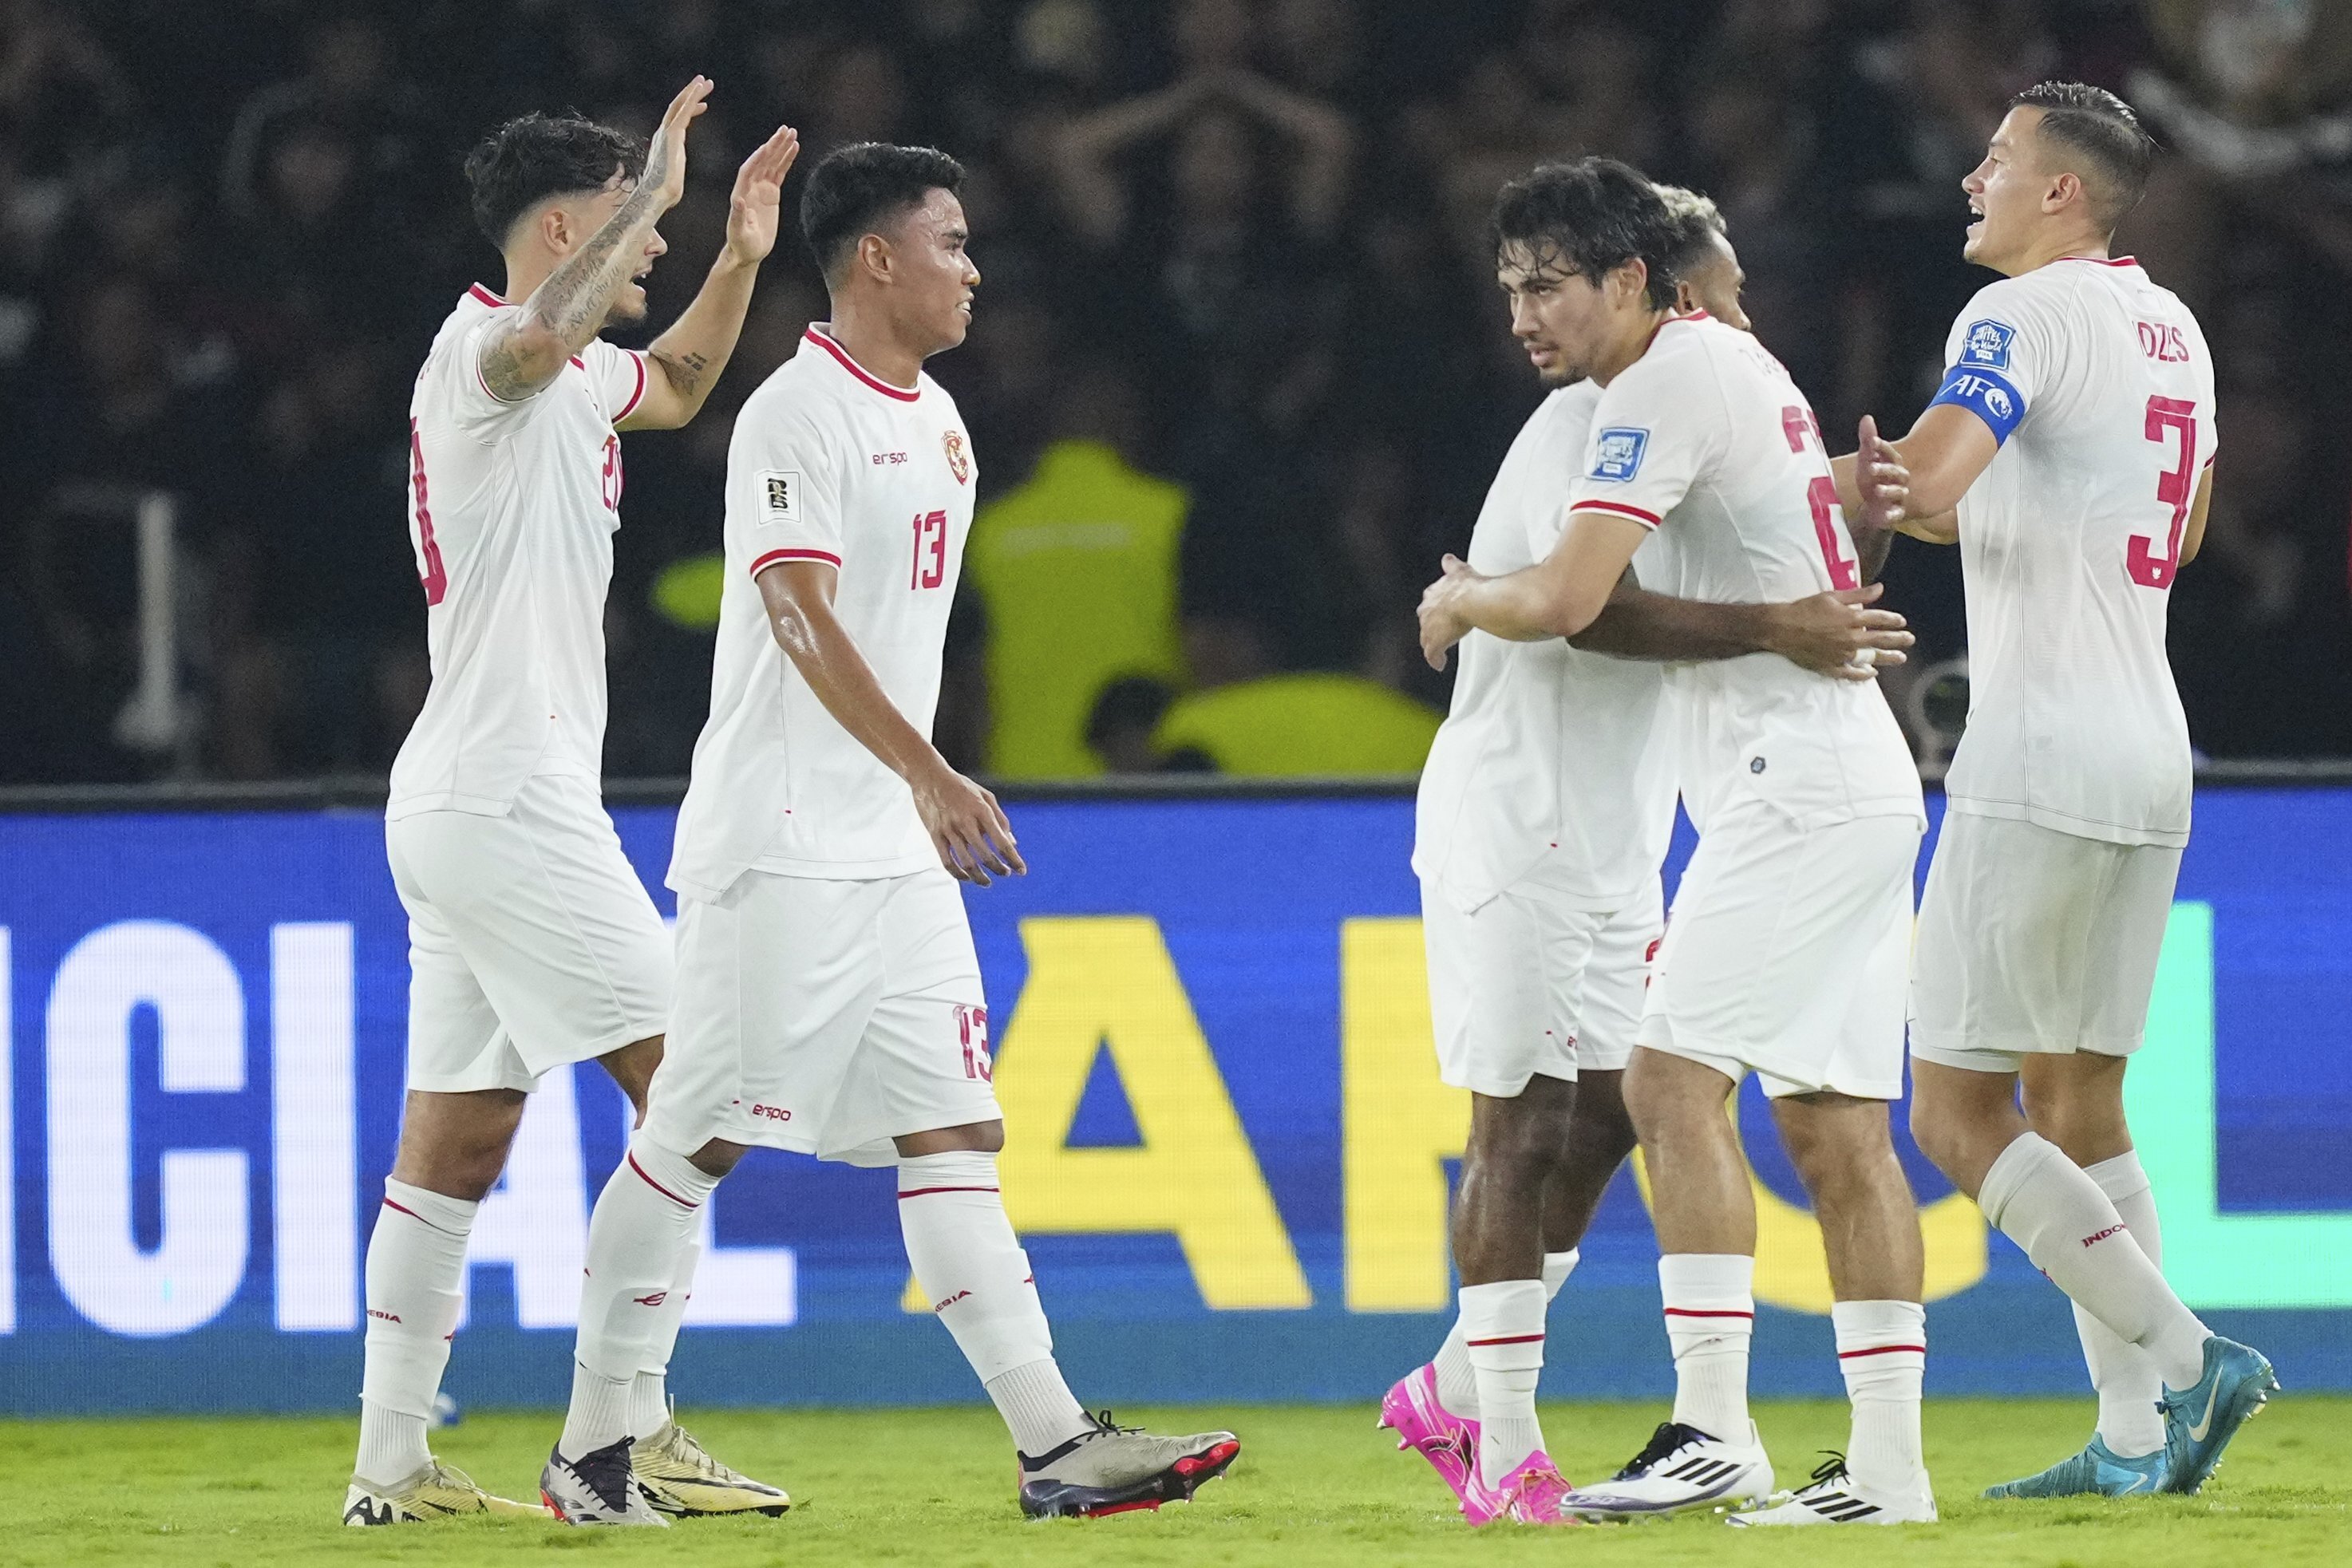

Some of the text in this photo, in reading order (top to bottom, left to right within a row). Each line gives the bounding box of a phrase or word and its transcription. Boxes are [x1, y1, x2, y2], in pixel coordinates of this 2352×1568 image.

[872, 452, 907, 466] erspo
[2126, 394, 2196, 590] 3
[911, 509, 947, 590] 13
[0, 919, 794, 1336] CIAL
